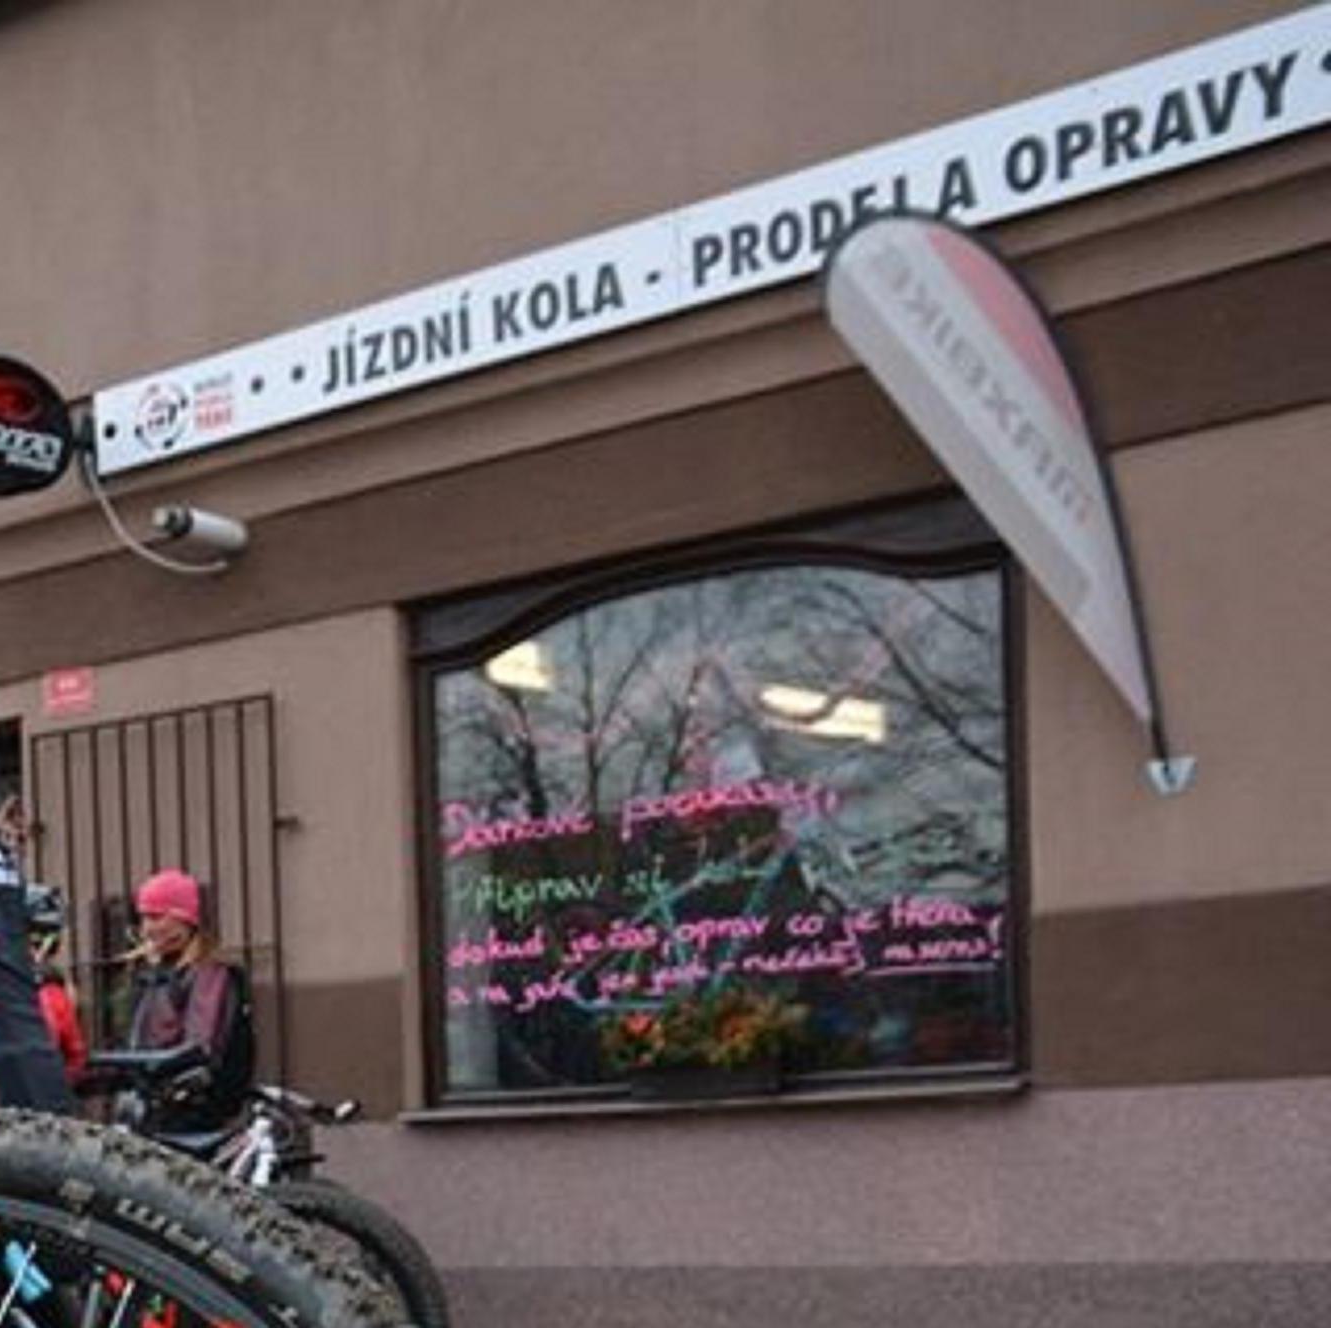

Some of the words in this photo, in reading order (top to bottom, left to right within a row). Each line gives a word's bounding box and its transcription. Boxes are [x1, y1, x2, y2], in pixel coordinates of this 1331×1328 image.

[322, 294, 472, 396] JÍZDNÍ
[492, 261, 624, 342] KOLA
[936, 156, 977, 220] A
[1003, 50, 1302, 195] OPRAVY
